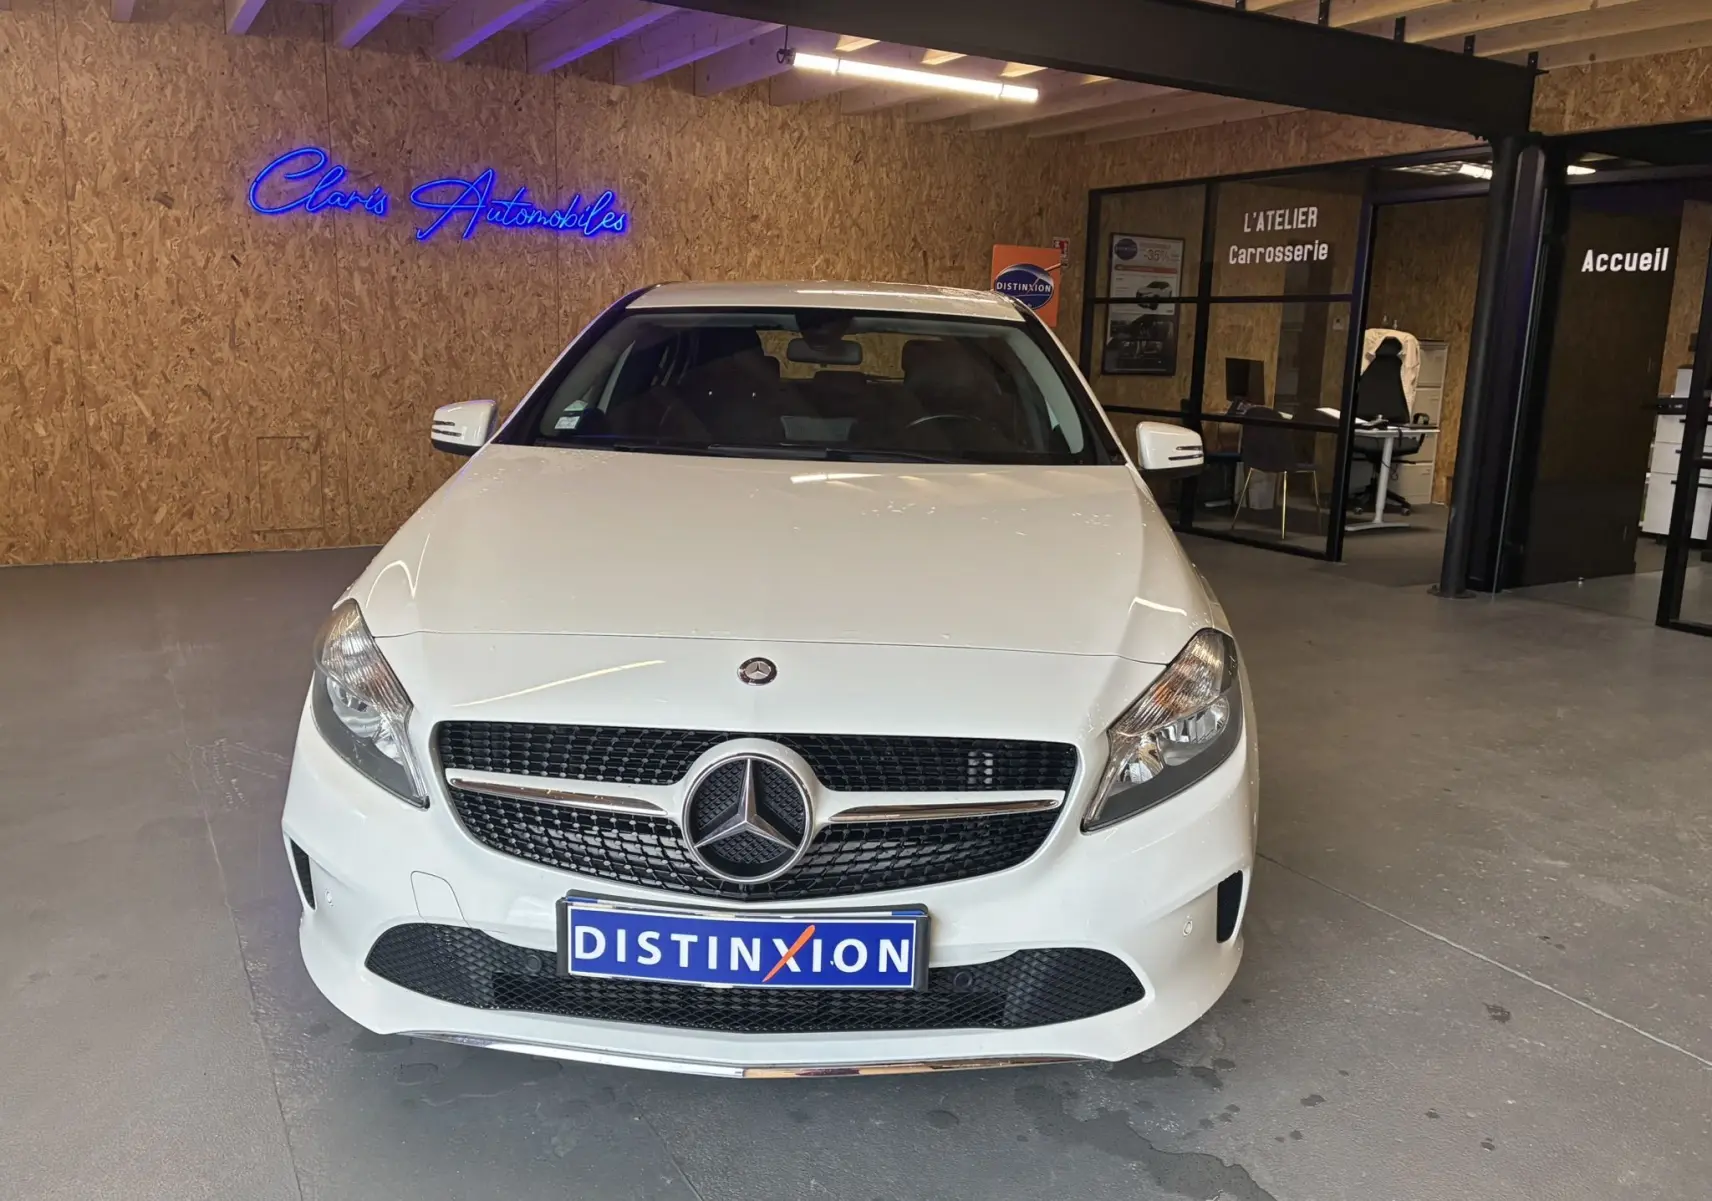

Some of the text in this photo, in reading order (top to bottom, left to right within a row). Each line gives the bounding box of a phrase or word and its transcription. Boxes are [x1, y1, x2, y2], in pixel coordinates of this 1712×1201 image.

[409, 168, 627, 241] Automobiles
[1243, 206, 1318, 233] L'ATELIER
[1228, 240, 1329, 265] Carrosserie
[1581, 247, 1669, 273] Accueil
[996, 280, 1051, 293] DISTINXION
[573, 924, 911, 983] DISTINXION
